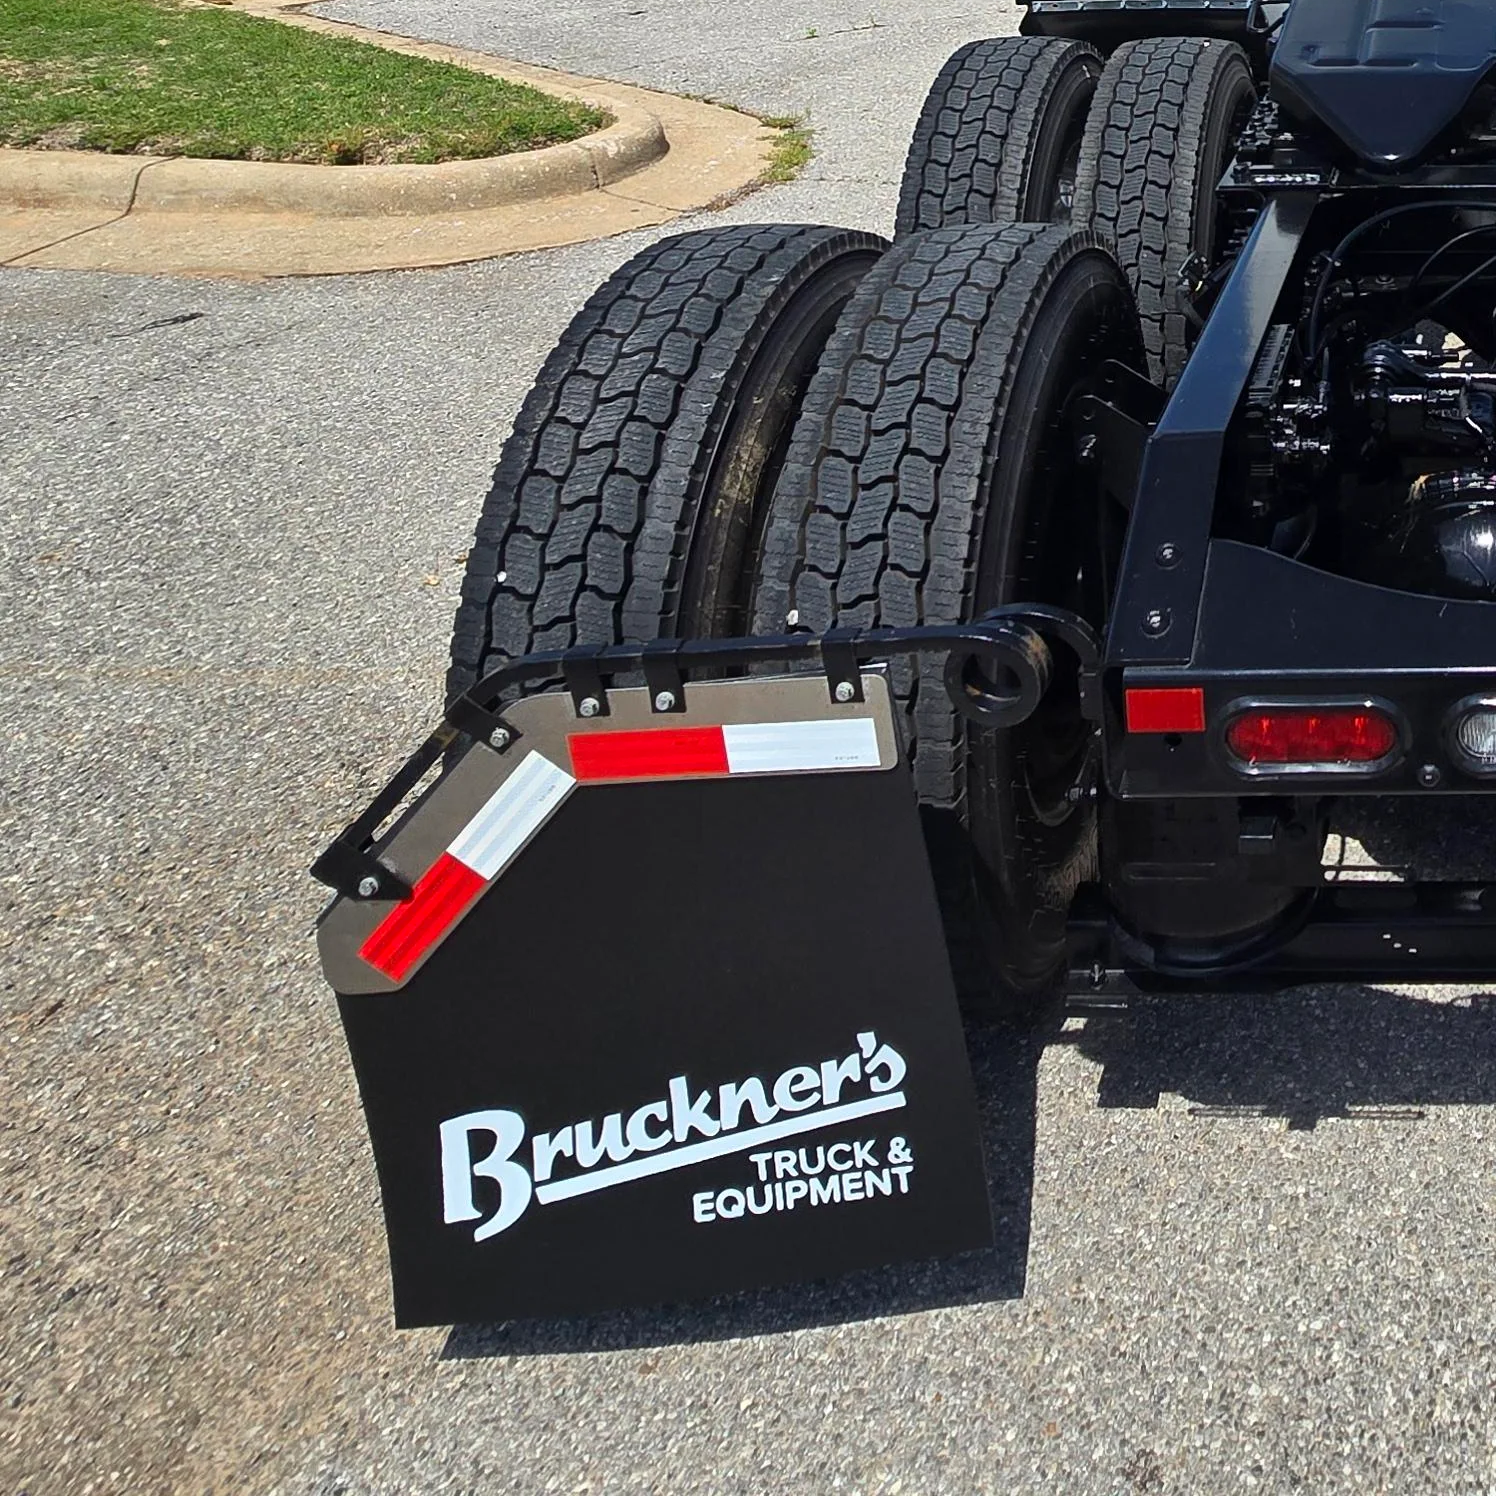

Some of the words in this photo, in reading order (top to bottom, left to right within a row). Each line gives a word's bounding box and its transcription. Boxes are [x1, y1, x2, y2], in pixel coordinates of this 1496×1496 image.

[439, 1030, 907, 1243] Bruckner's
[748, 1139, 880, 1182] TRUCK
[887, 1136, 914, 1165] &
[692, 1165, 914, 1224] EQUIPMENT
